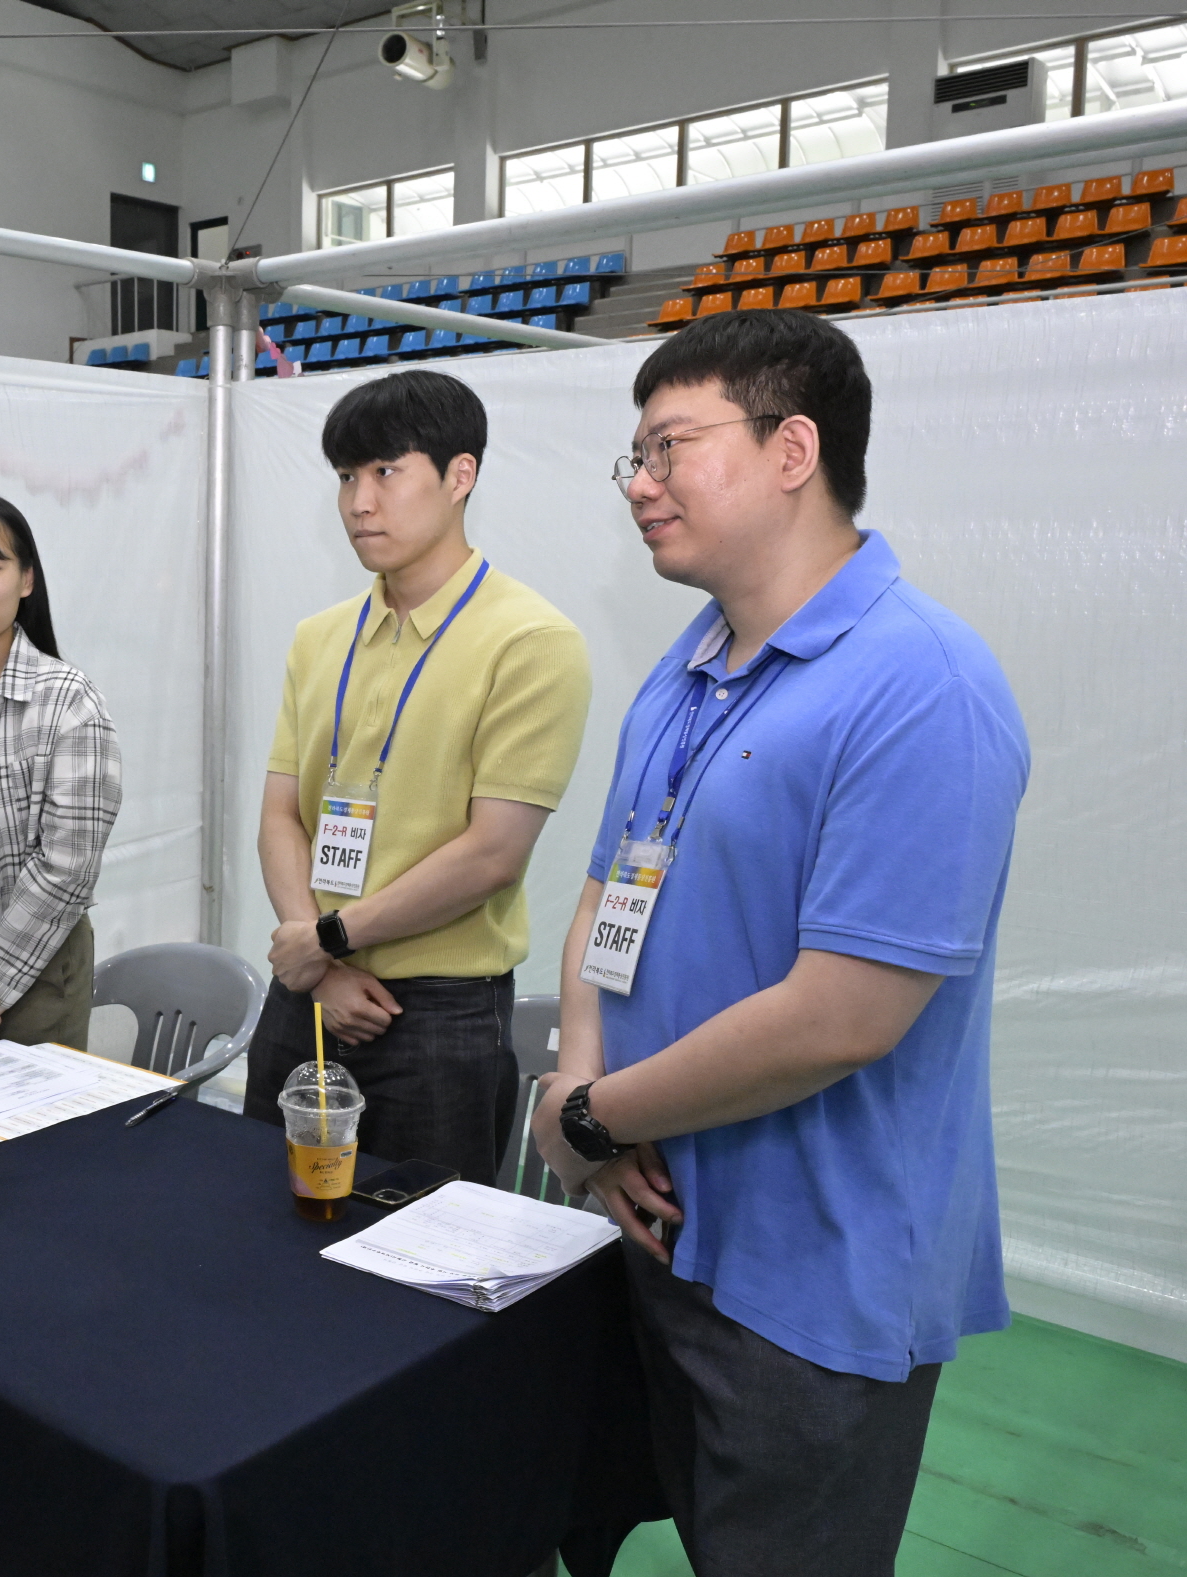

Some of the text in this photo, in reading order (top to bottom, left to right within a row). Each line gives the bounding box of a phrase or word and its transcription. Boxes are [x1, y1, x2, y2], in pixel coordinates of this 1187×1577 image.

[323, 824, 367, 840] F-2-R 비자
[320, 844, 363, 869] STAFF
[604, 894, 648, 916] F-2-R 비자
[593, 921, 638, 954] STAFF
